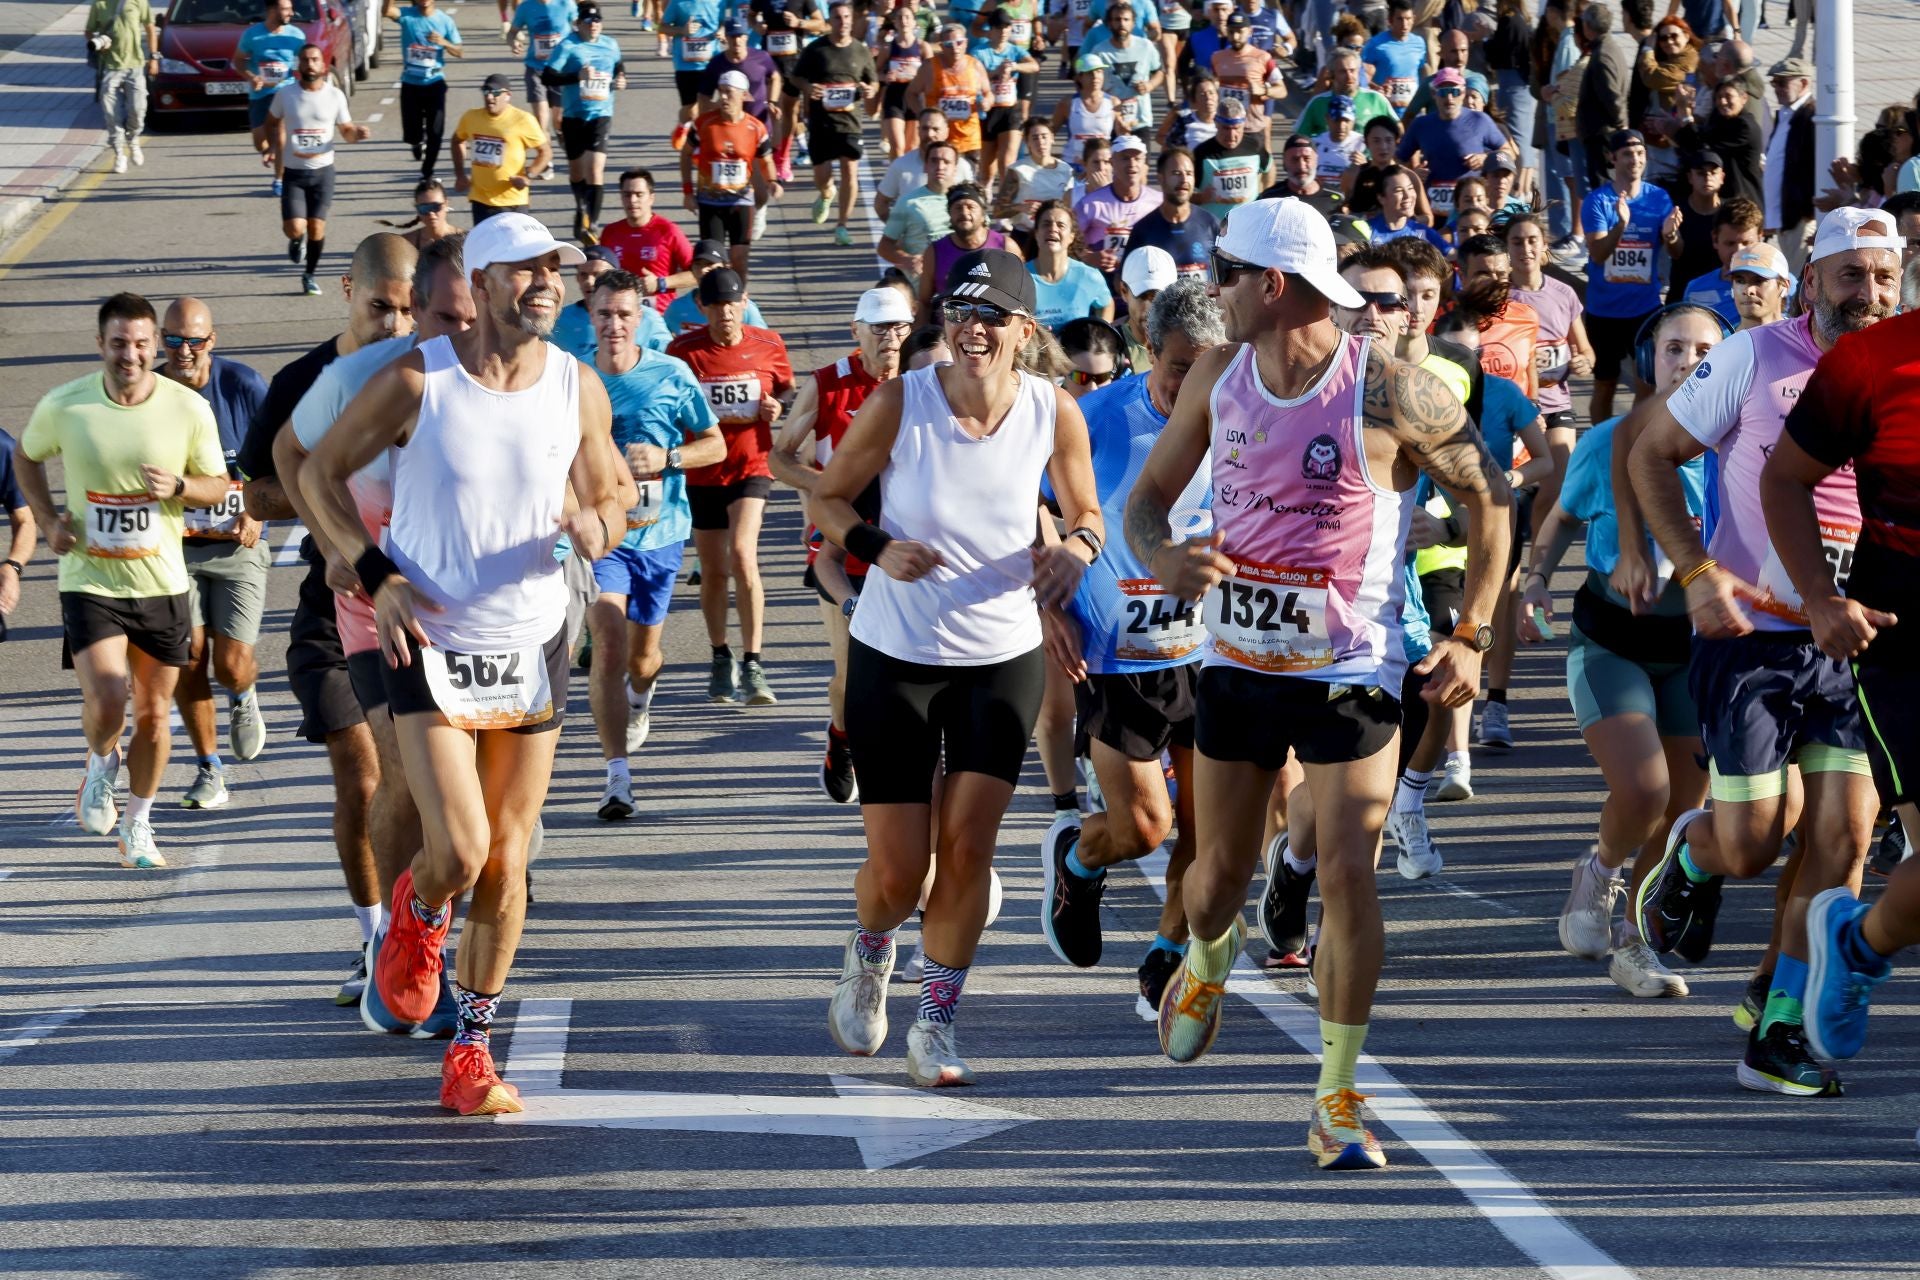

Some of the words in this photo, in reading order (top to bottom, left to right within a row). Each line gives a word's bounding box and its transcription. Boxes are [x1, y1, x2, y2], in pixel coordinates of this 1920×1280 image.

[474, 140, 503, 157] 2276
[1219, 175, 1249, 192] 1081
[1612, 249, 1648, 268] 1984
[710, 384, 749, 405] 563
[1244, 490, 1346, 518] Monolito
[95, 506, 151, 534] 1750
[1279, 571, 1308, 582] GIJÓN
[1218, 578, 1311, 635] 1324
[444, 650, 524, 690] 562
